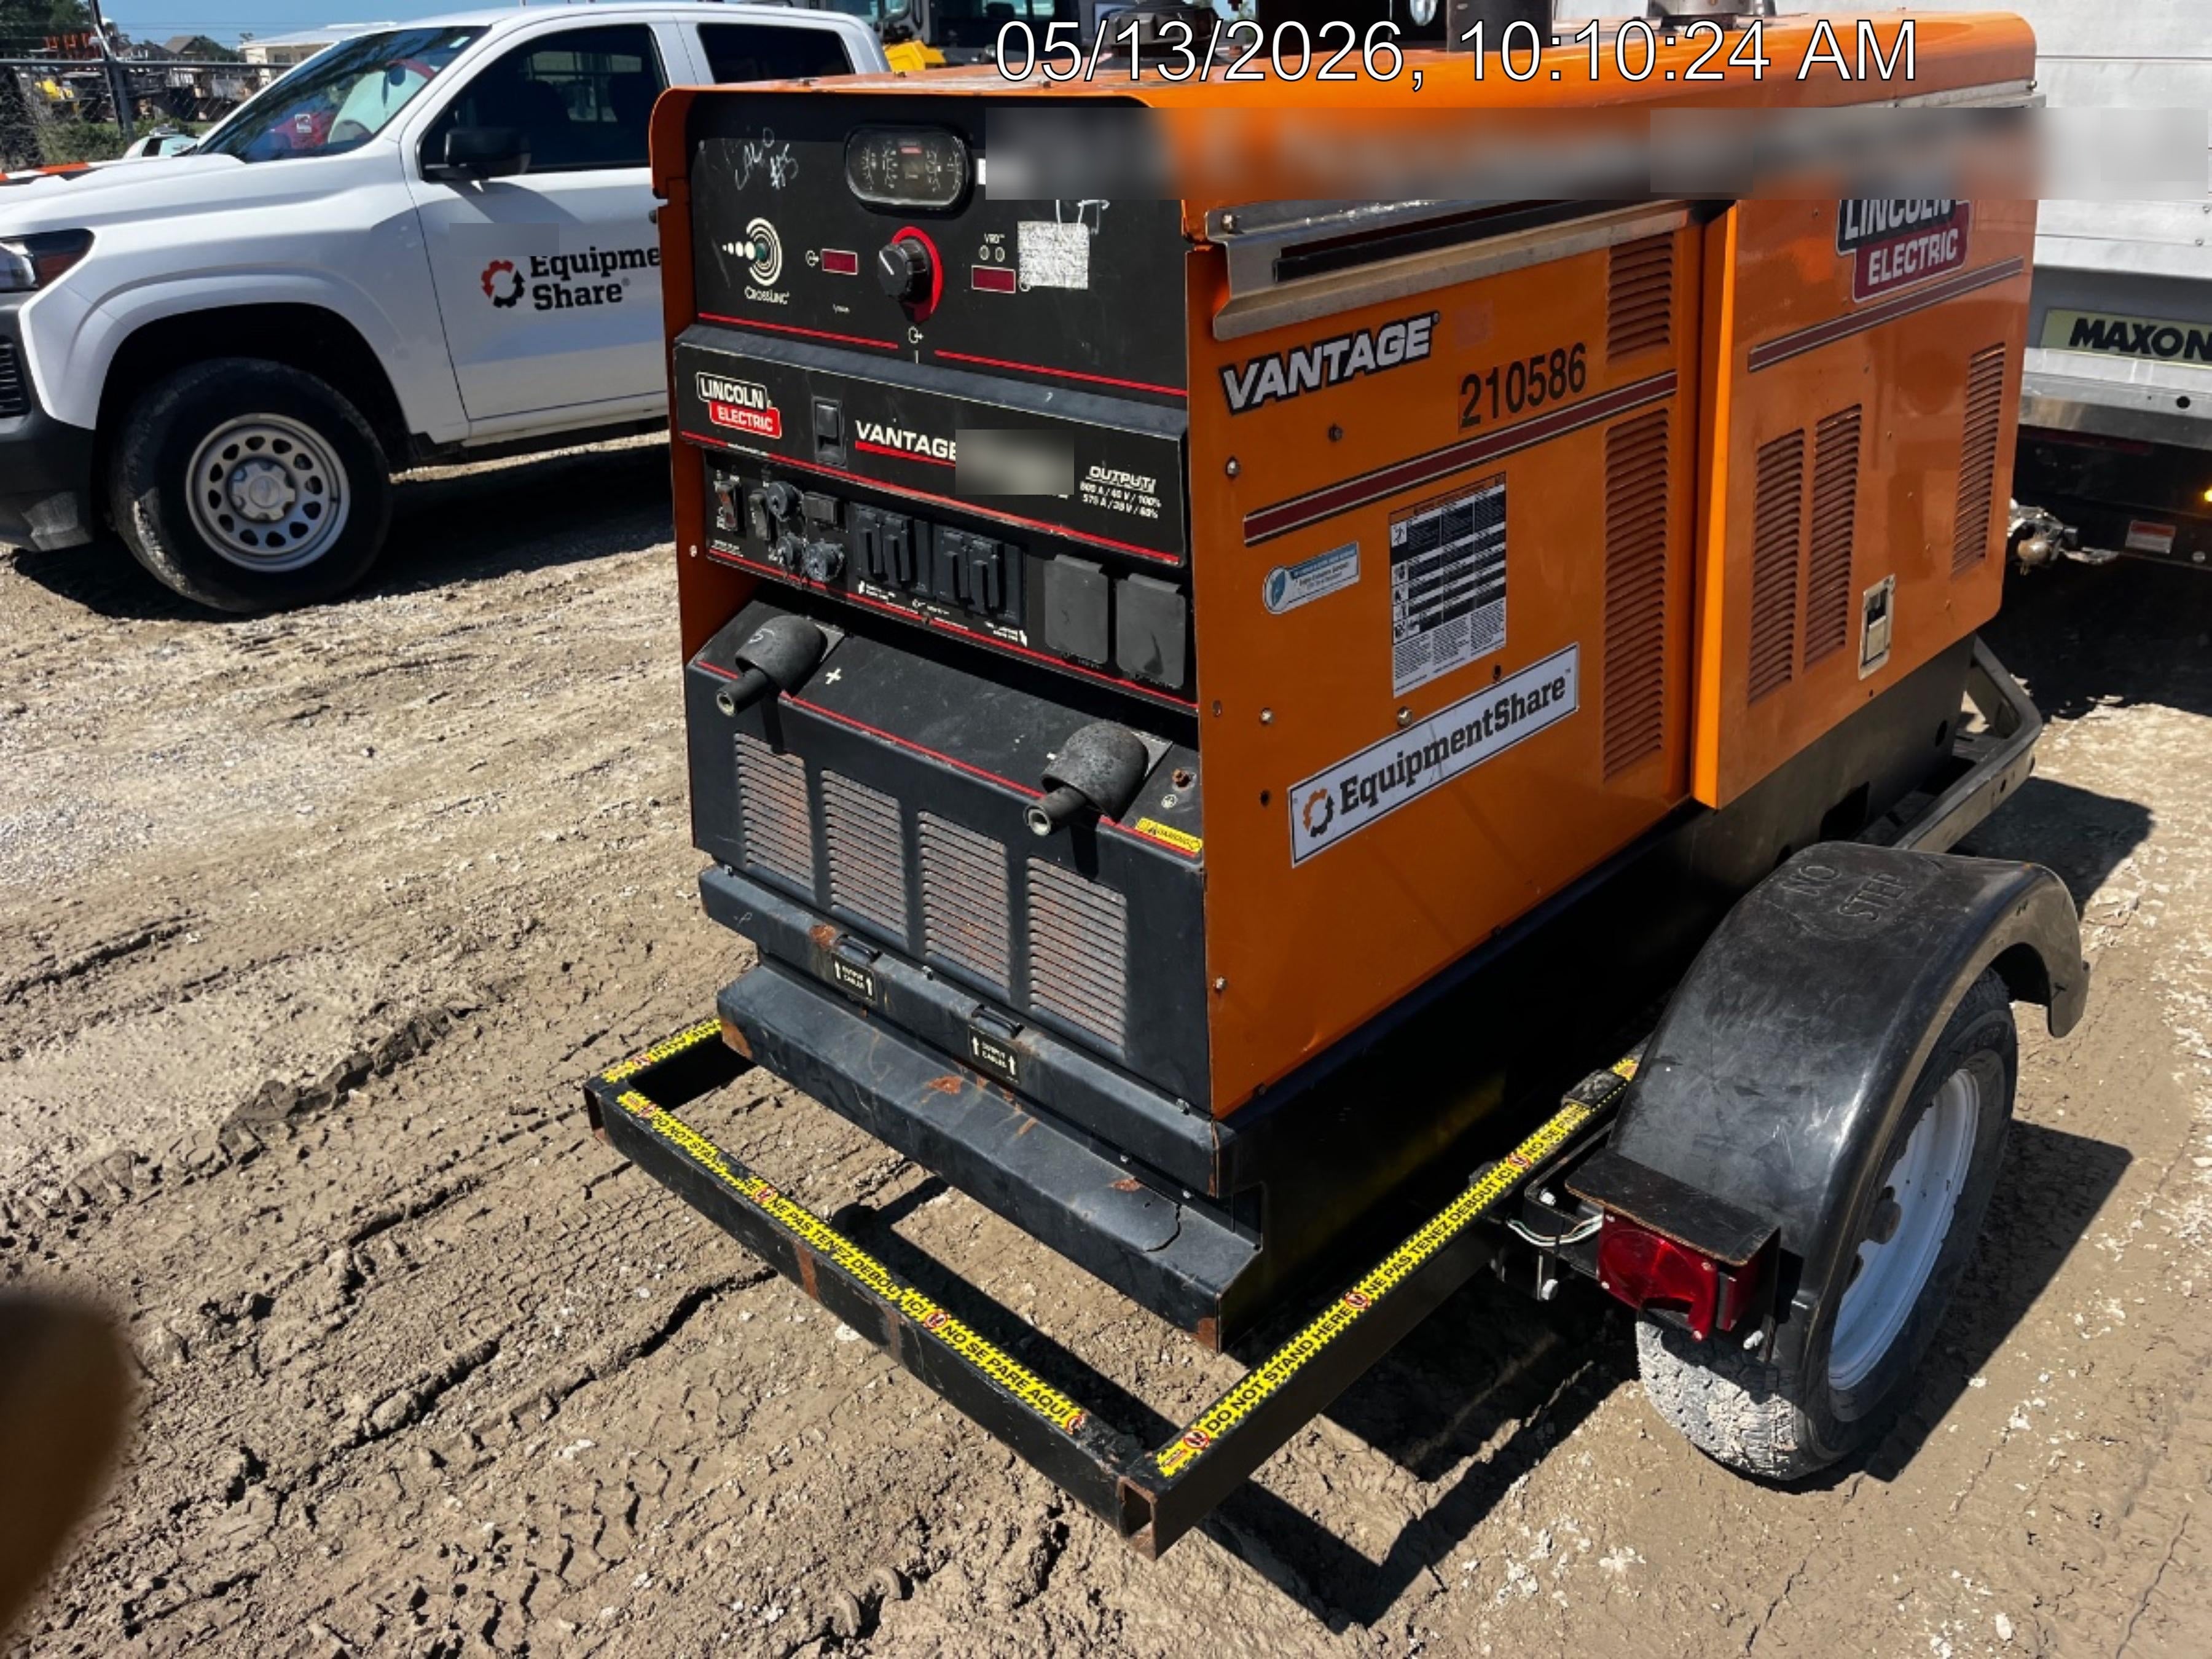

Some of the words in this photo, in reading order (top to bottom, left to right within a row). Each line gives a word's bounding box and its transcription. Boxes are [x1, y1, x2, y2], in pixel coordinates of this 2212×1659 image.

[532, 283, 608, 310] Share
[1868, 229, 1958, 286] ELECTRIC
[1220, 313, 1434, 414] VANTAGE
[2068, 317, 2212, 361] MAXON
[700, 377, 764, 410] LINCOLN
[717, 406, 773, 431] ELECTRIC
[1461, 342, 1586, 428] 210586
[1339, 676, 1566, 815] EquipmentShare
[651, 1113, 670, 1128] DO
[770, 1199, 789, 1214] NE
[788, 1212, 813, 1231] PAS
[851, 1258, 900, 1295] DEBOU
[905, 1297, 927, 1314] ICI
[1363, 1278, 1387, 1295] NE
[1383, 1255, 1413, 1278] PAS
[1410, 1221, 1451, 1255] TENEZ
[1448, 1180, 1498, 1222] DEBOUT
[943, 1325, 967, 1343] NO
[965, 1342, 987, 1359] SE
[987, 1357, 1030, 1390] PARE
[1029, 1388, 1070, 1419] AQUI
[1205, 1409, 1233, 1433] DO
[1230, 1382, 1265, 1411] NOT
[1263, 1339, 1314, 1382] STAND
[1312, 1306, 1352, 1341] HERE
